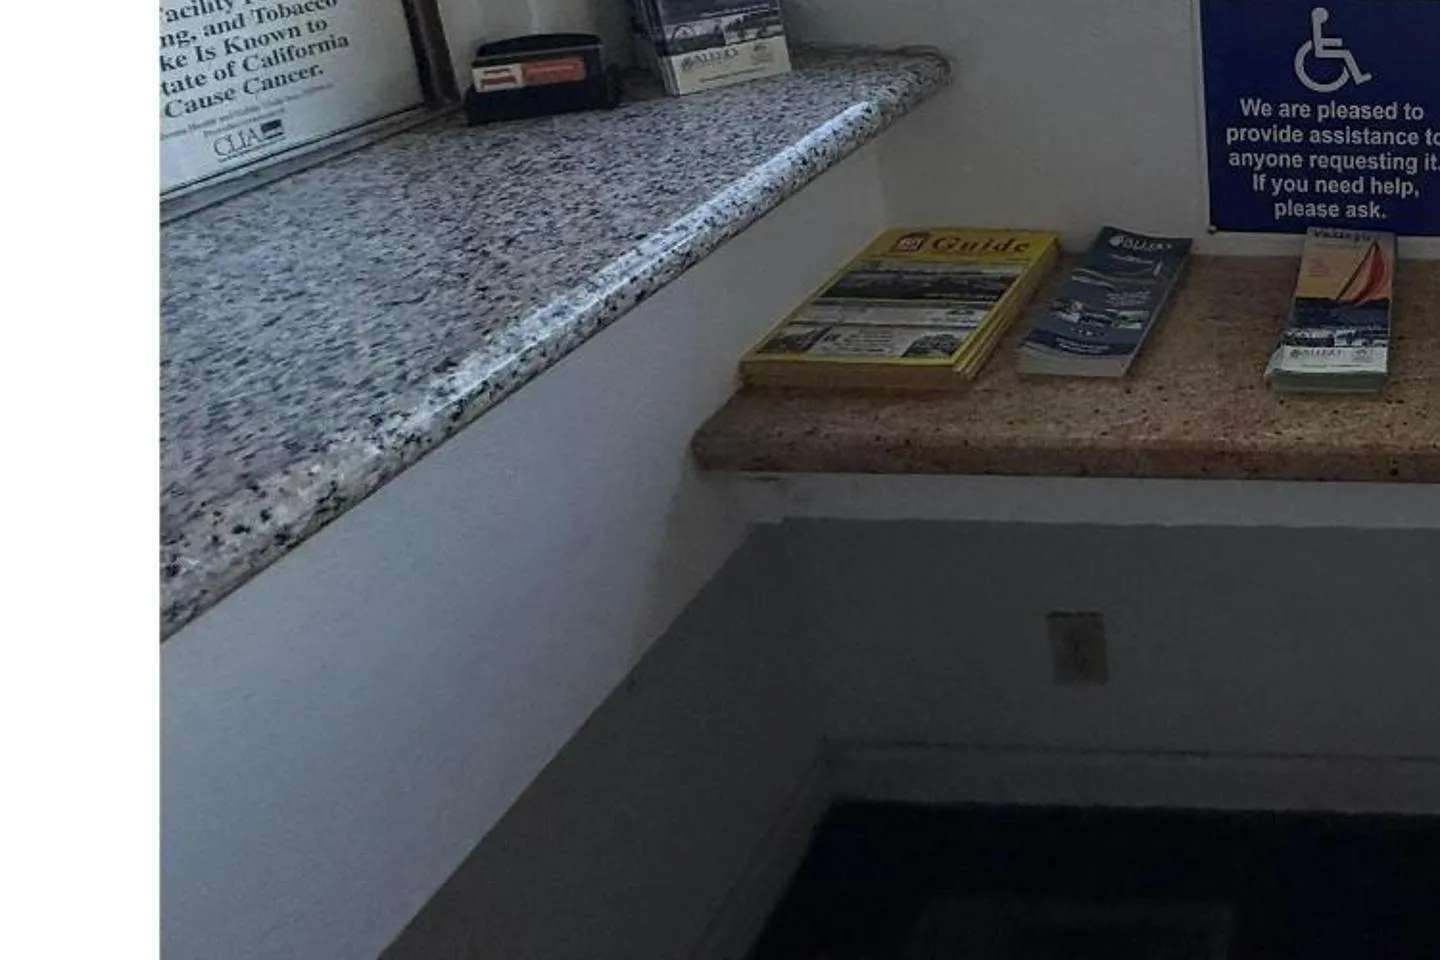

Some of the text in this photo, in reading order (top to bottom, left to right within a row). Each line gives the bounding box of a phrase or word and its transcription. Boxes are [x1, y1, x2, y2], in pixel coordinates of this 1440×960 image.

[203, 11, 246, 38] and
[195, 44, 217, 63] Is
[224, 24, 302, 56] Known
[308, 18, 328, 34] to
[214, 60, 236, 82] of
[242, 34, 350, 73] California
[165, 89, 236, 118] Cause
[243, 64, 324, 96] Cancer.
[1240, 98, 1424, 122] We are pleased to
[1226, 124, 1303, 145] provide
[1309, 126, 1420, 146] assistance
[1229, 151, 1303, 170] anyone
[1309, 151, 1418, 175] requesting
[1252, 173, 1419, 198] If you need help,
[1274, 199, 1386, 220] please ask.
[931, 235, 1031, 256] Guide
